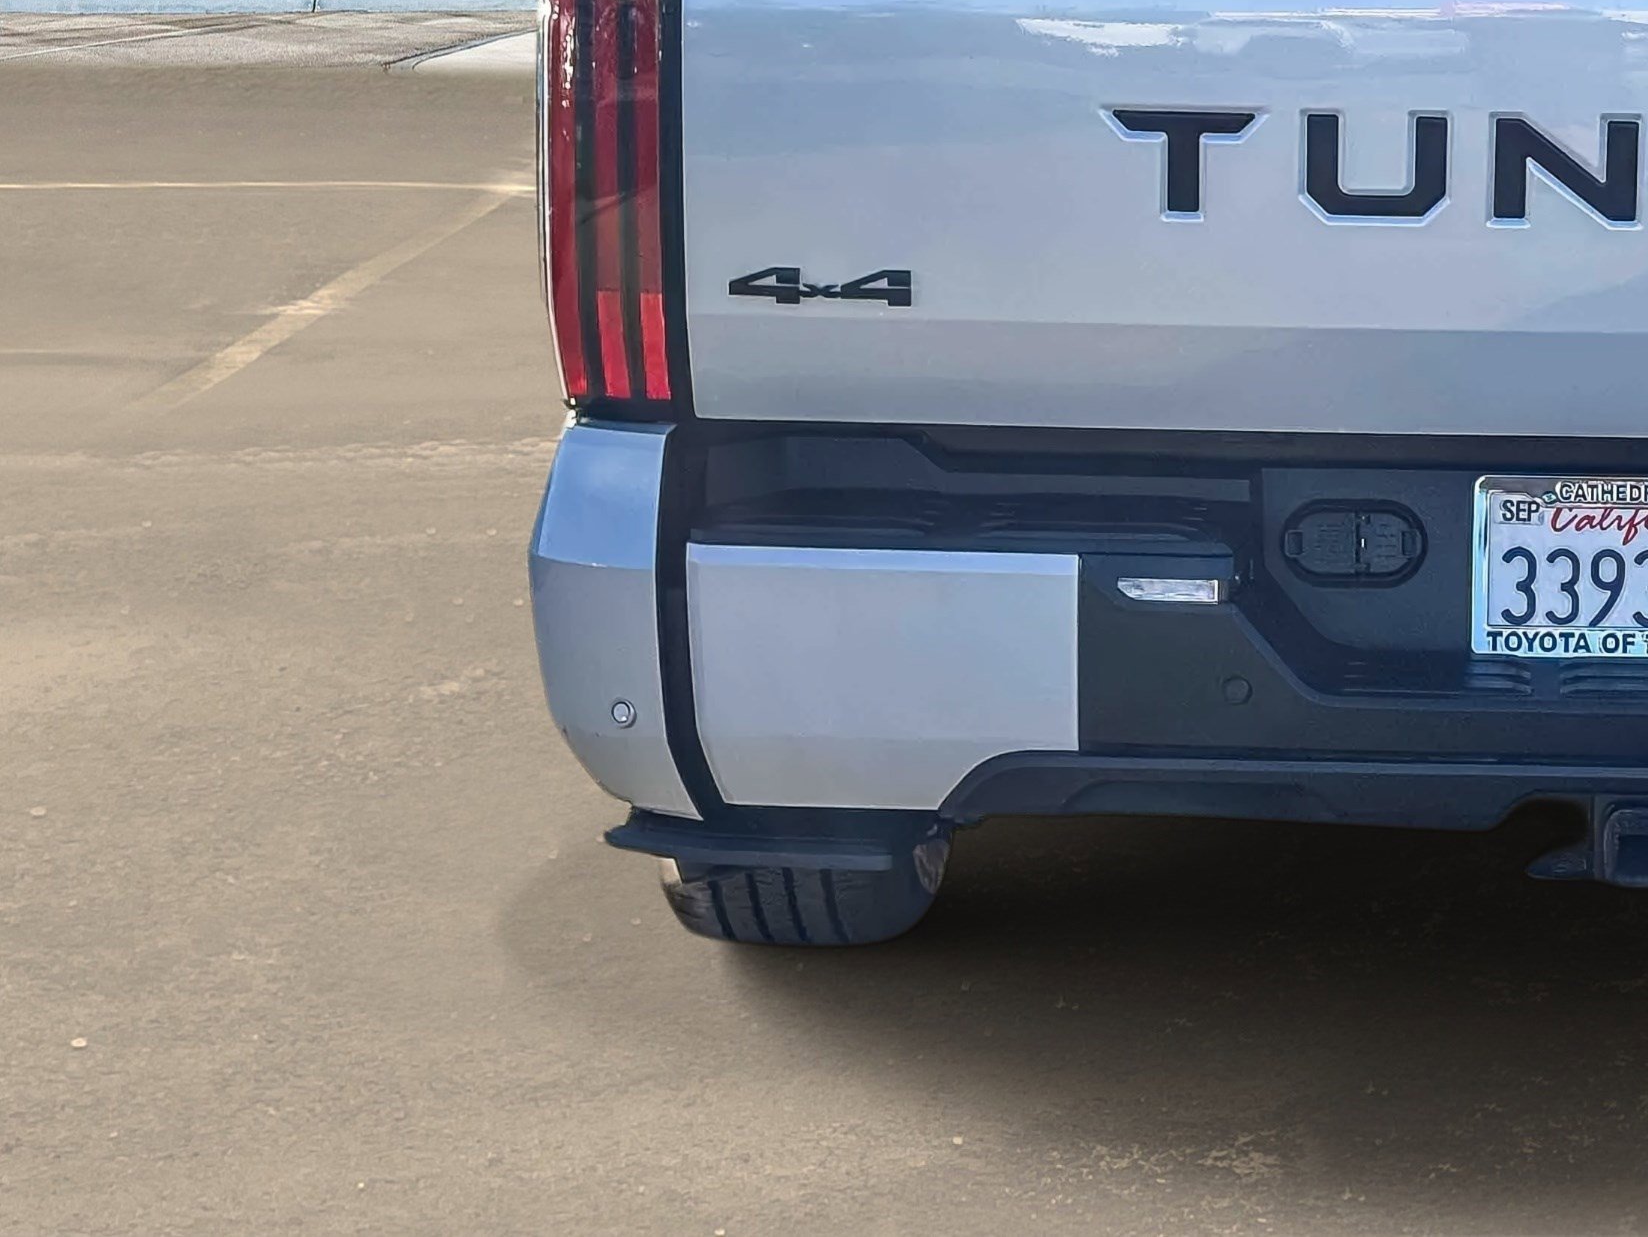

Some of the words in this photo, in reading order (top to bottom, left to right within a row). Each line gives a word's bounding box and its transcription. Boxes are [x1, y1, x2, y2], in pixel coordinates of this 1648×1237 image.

[728, 266, 912, 307] 4x4
[1502, 501, 1540, 522] SEP
[1487, 631, 1589, 654] TOYOTA
[1601, 633, 1635, 654] OF
